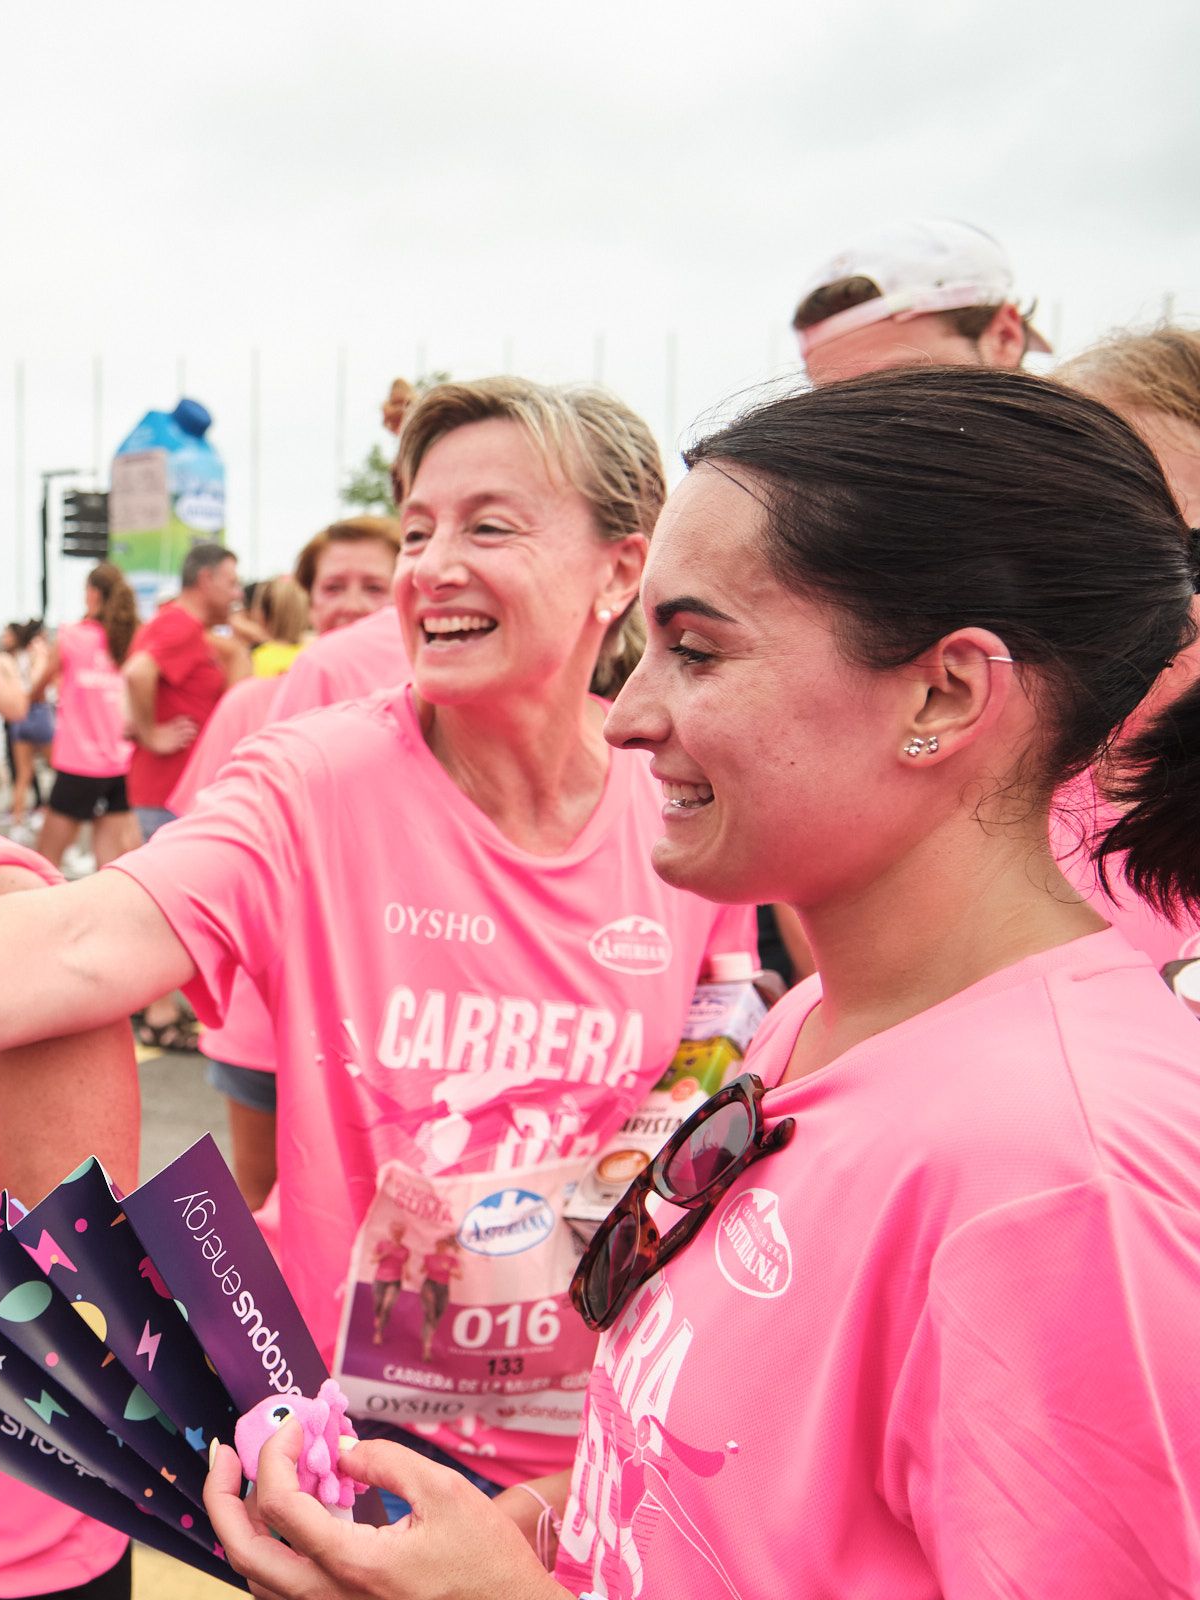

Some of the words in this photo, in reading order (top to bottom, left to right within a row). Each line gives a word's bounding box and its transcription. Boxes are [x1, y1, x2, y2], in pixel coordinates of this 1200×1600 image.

[384, 901, 497, 945] OYSHO
[377, 985, 644, 1088] CARRERA
[452, 1299, 560, 1349] 016
[487, 1356, 524, 1376] 133
[366, 1395, 464, 1416] OYSHO
